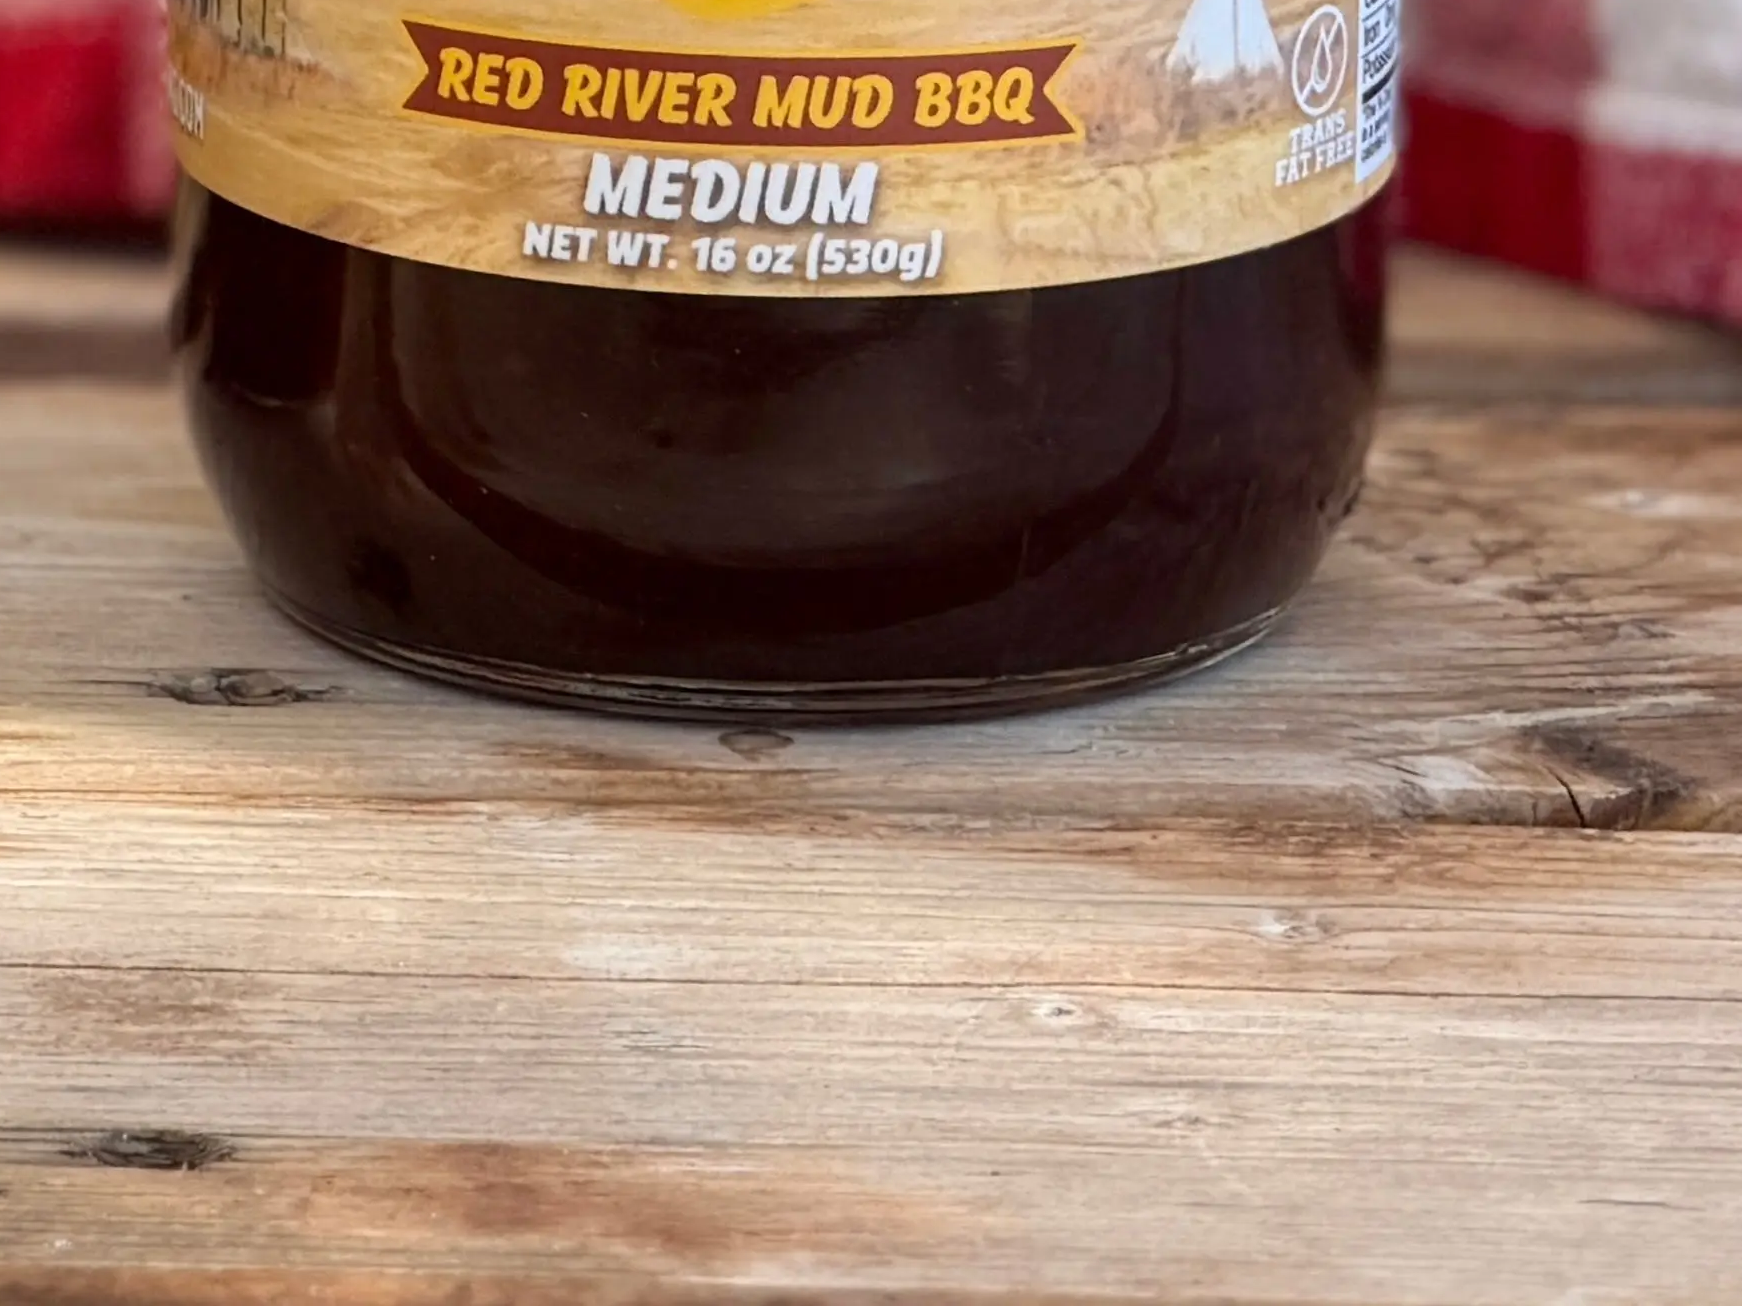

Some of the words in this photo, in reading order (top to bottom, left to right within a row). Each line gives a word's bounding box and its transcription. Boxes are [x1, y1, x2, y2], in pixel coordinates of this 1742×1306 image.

[436, 46, 543, 111] RED
[562, 62, 737, 128] RIVER
[751, 73, 894, 130] MUD
[913, 65, 1036, 128] BBQ
[1274, 151, 1312, 188] FAT
[1314, 130, 1355, 176] FREE
[1288, 108, 1346, 155] TRANS
[583, 151, 879, 225] MEDIUM
[522, 221, 596, 262] NET
[608, 230, 678, 269] WT.
[691, 235, 737, 271] 16
[745, 244, 796, 275] oz
[805, 228, 943, 281] (530g)
